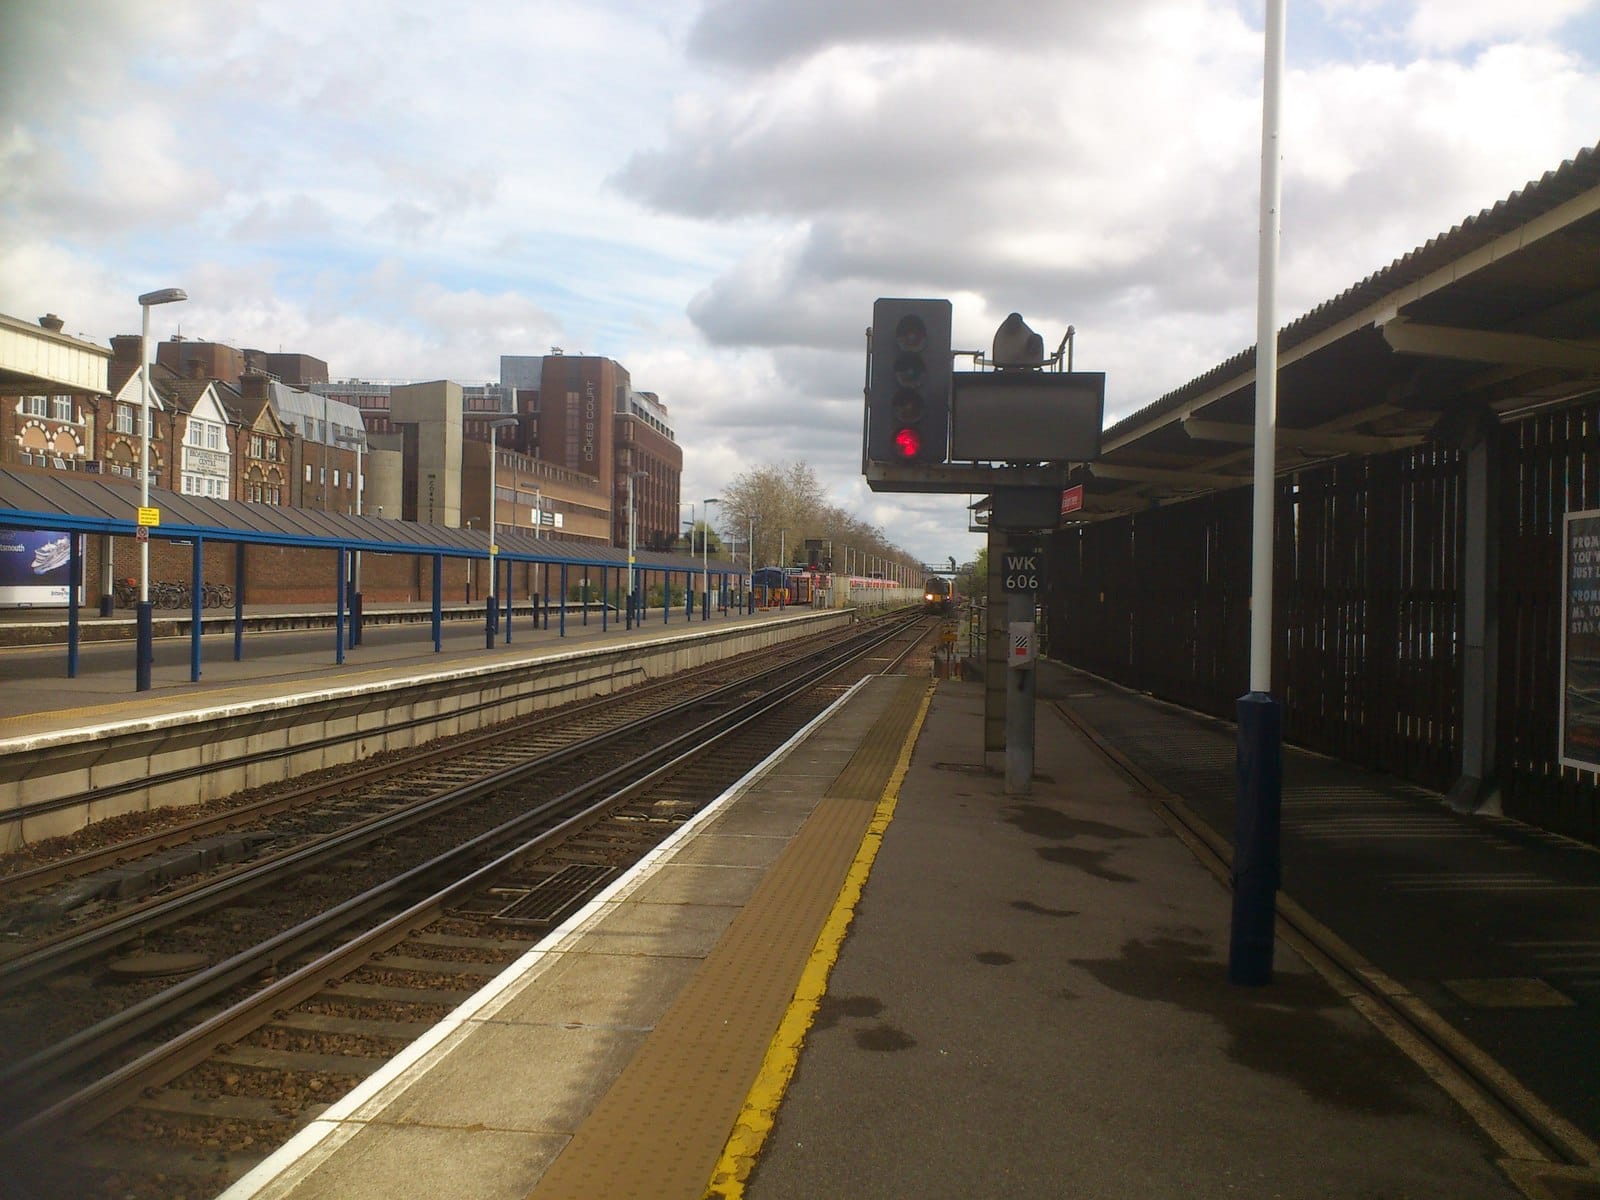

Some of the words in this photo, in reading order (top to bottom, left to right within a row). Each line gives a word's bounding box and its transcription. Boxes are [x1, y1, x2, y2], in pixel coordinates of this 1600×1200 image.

[586, 380, 594, 419] COURT
[1008, 557, 1036, 570] WK
[1572, 566, 1592, 578] JUST
[1006, 575, 1039, 588] 606
